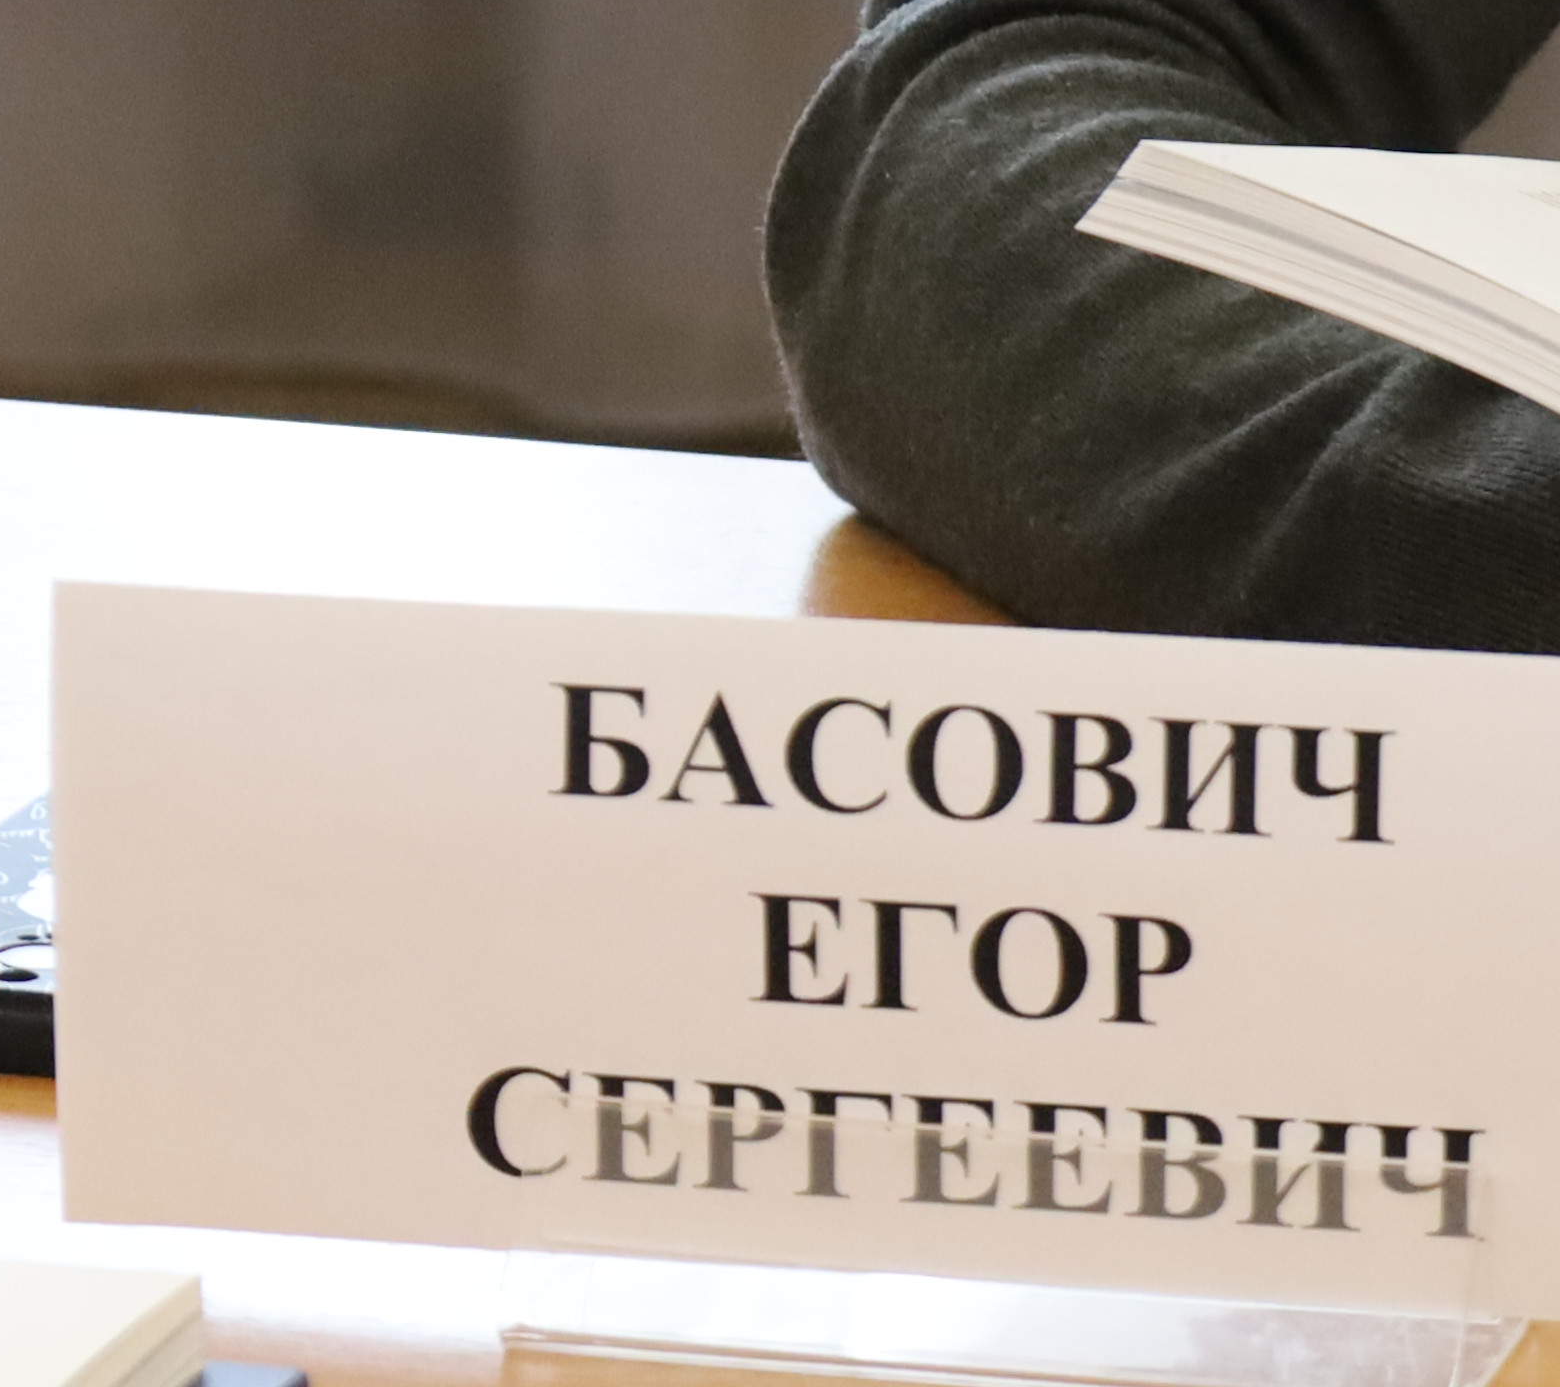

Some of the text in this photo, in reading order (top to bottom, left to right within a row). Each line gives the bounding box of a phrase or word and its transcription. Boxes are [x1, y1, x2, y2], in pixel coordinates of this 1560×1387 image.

[550, 681, 1397, 847] БАСОВИЧ
[750, 891, 1197, 1027] ЕГОР
[463, 1063, 1490, 1242] СЕРГЕЕВИЧ
